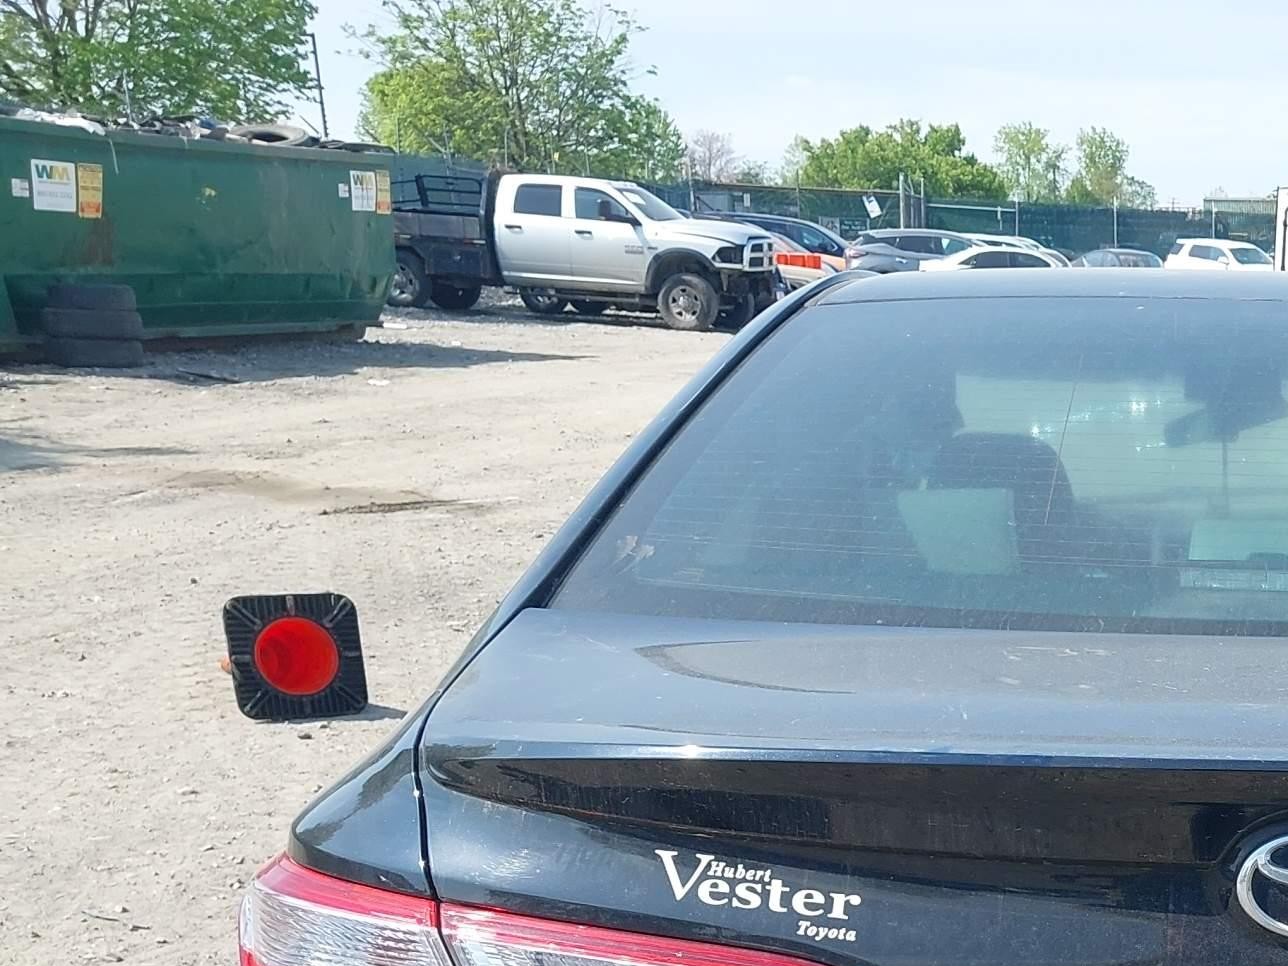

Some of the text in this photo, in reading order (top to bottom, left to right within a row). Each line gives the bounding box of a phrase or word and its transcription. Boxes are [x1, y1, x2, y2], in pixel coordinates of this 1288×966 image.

[34, 164, 70, 181] WM
[707, 860, 772, 882] Hubert
[654, 849, 862, 920] Vester
[796, 920, 857, 942] Toyota
